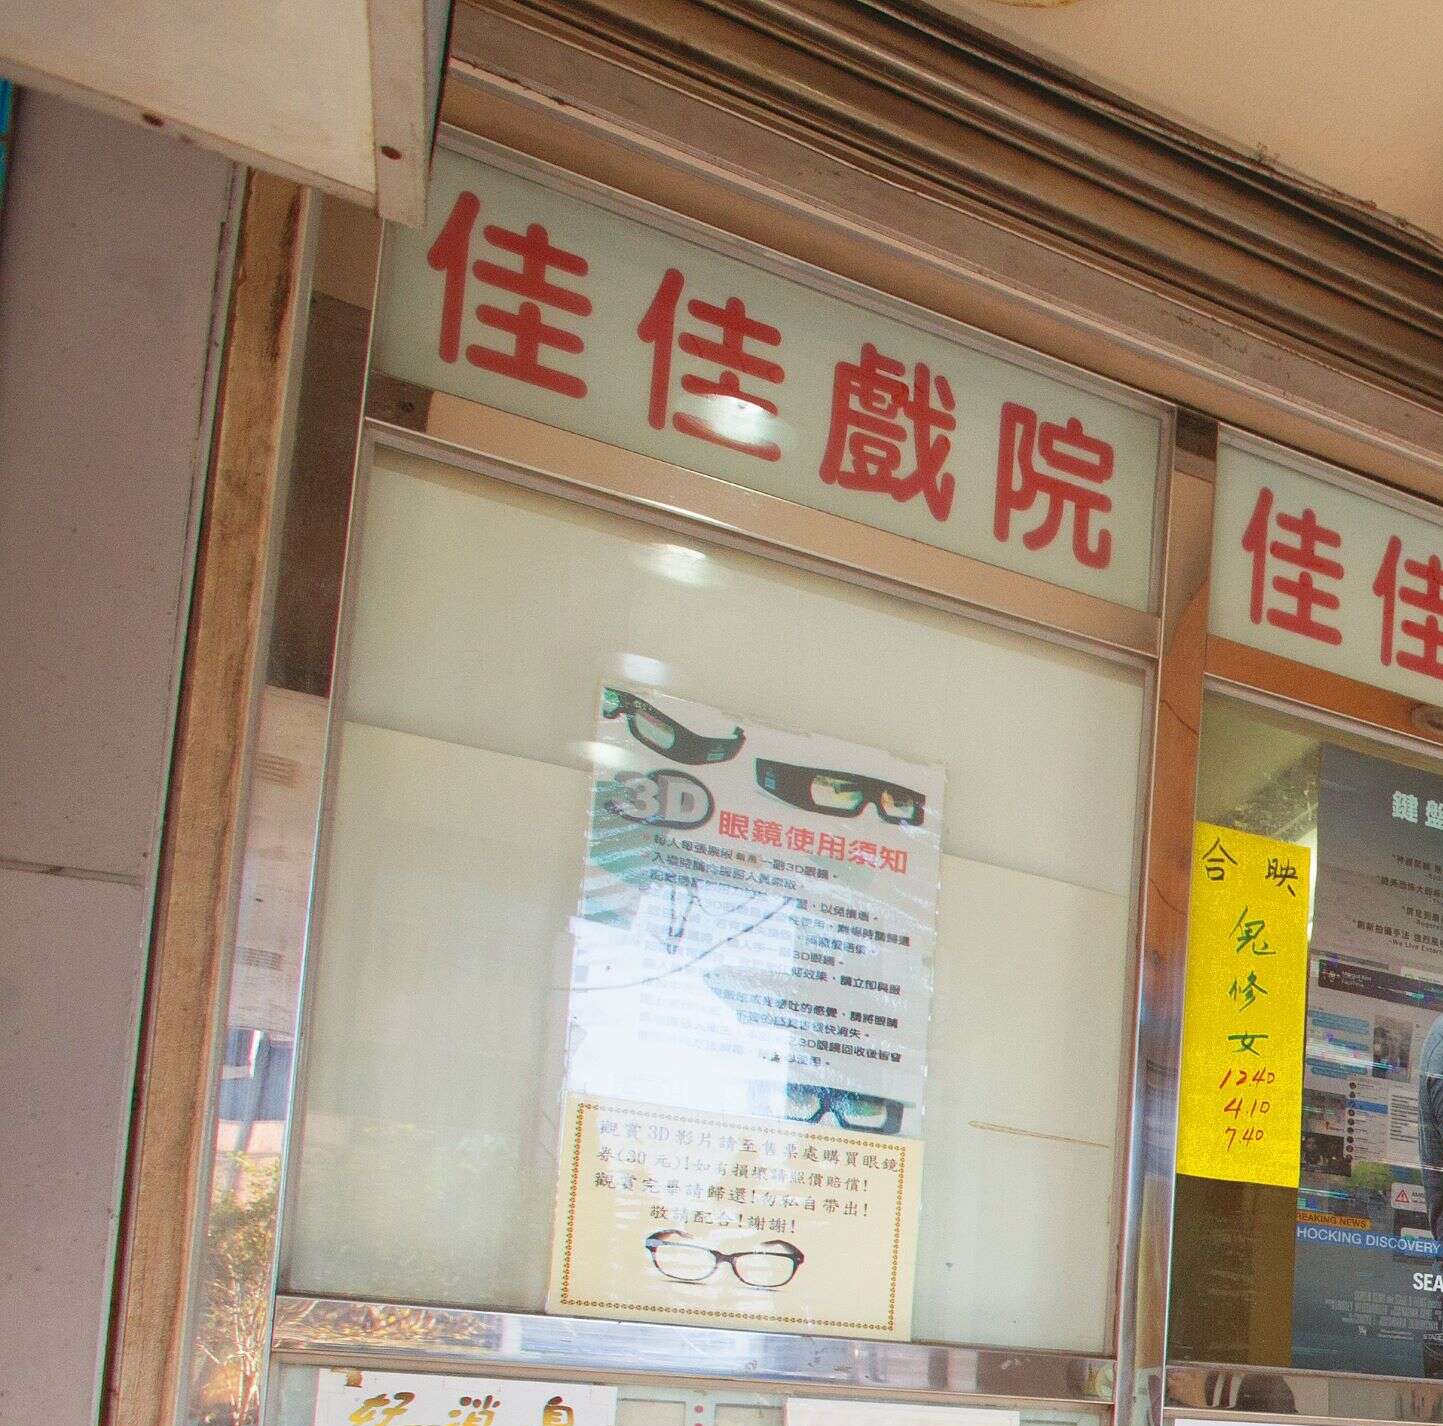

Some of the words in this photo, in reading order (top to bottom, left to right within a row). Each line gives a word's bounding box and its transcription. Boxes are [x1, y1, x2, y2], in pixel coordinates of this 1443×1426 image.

[426, 191, 1114, 570] 佳佳戲院
[719, 810, 909, 874] 眼鏡使用須知
[1340, 1217, 1367, 1227] NEWS
[1366, 1234, 1441, 1254] DISCOVERY
